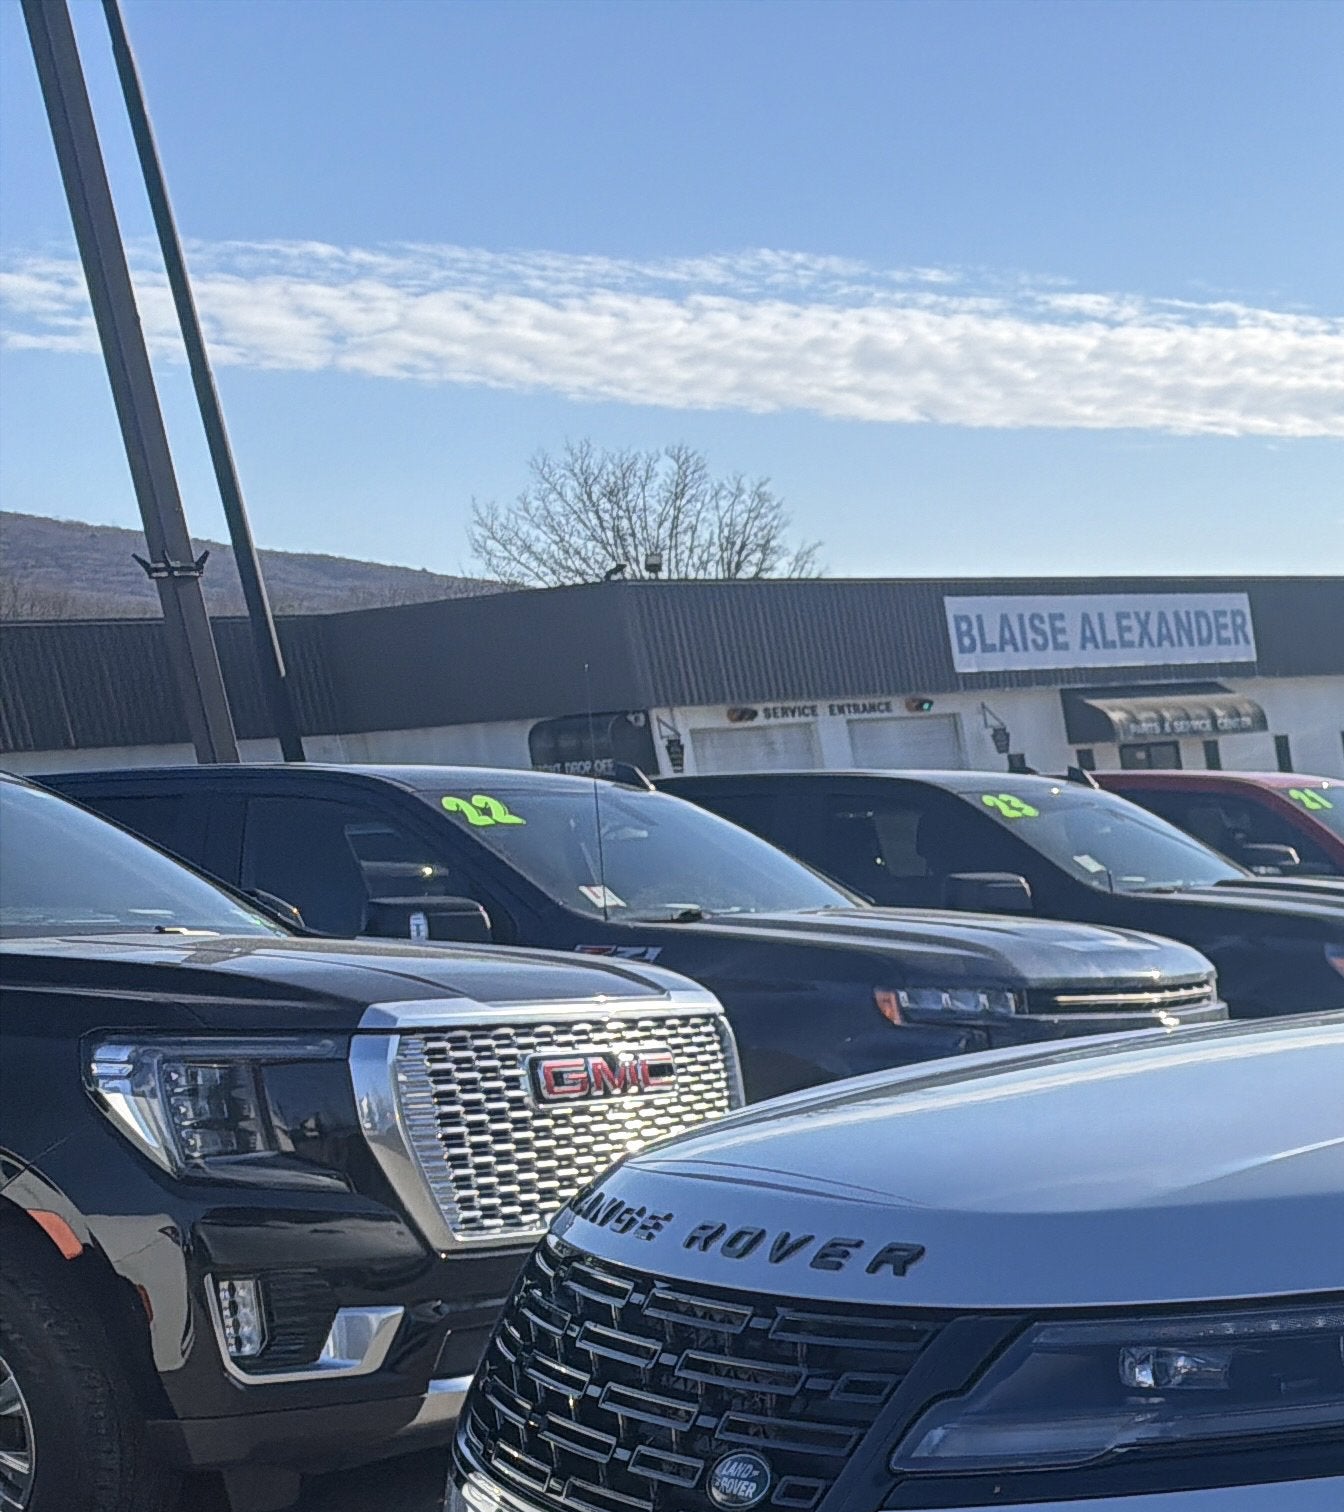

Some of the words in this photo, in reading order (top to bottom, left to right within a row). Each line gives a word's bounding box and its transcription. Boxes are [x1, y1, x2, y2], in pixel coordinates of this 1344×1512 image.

[954, 612, 1069, 654] BLAISE
[1079, 608, 1251, 650] ALEXANDER
[763, 705, 818, 720] SERVICE
[828, 701, 893, 716] ENTRANCE
[441, 794, 526, 826] 22
[1289, 788, 1334, 811] 21
[538, 1051, 676, 1100] GMC
[570, 1190, 674, 1241] ANGE
[683, 1219, 926, 1278] ROVER
[722, 1460, 754, 1479] LAND
[719, 1477, 757, 1499] ROVER
